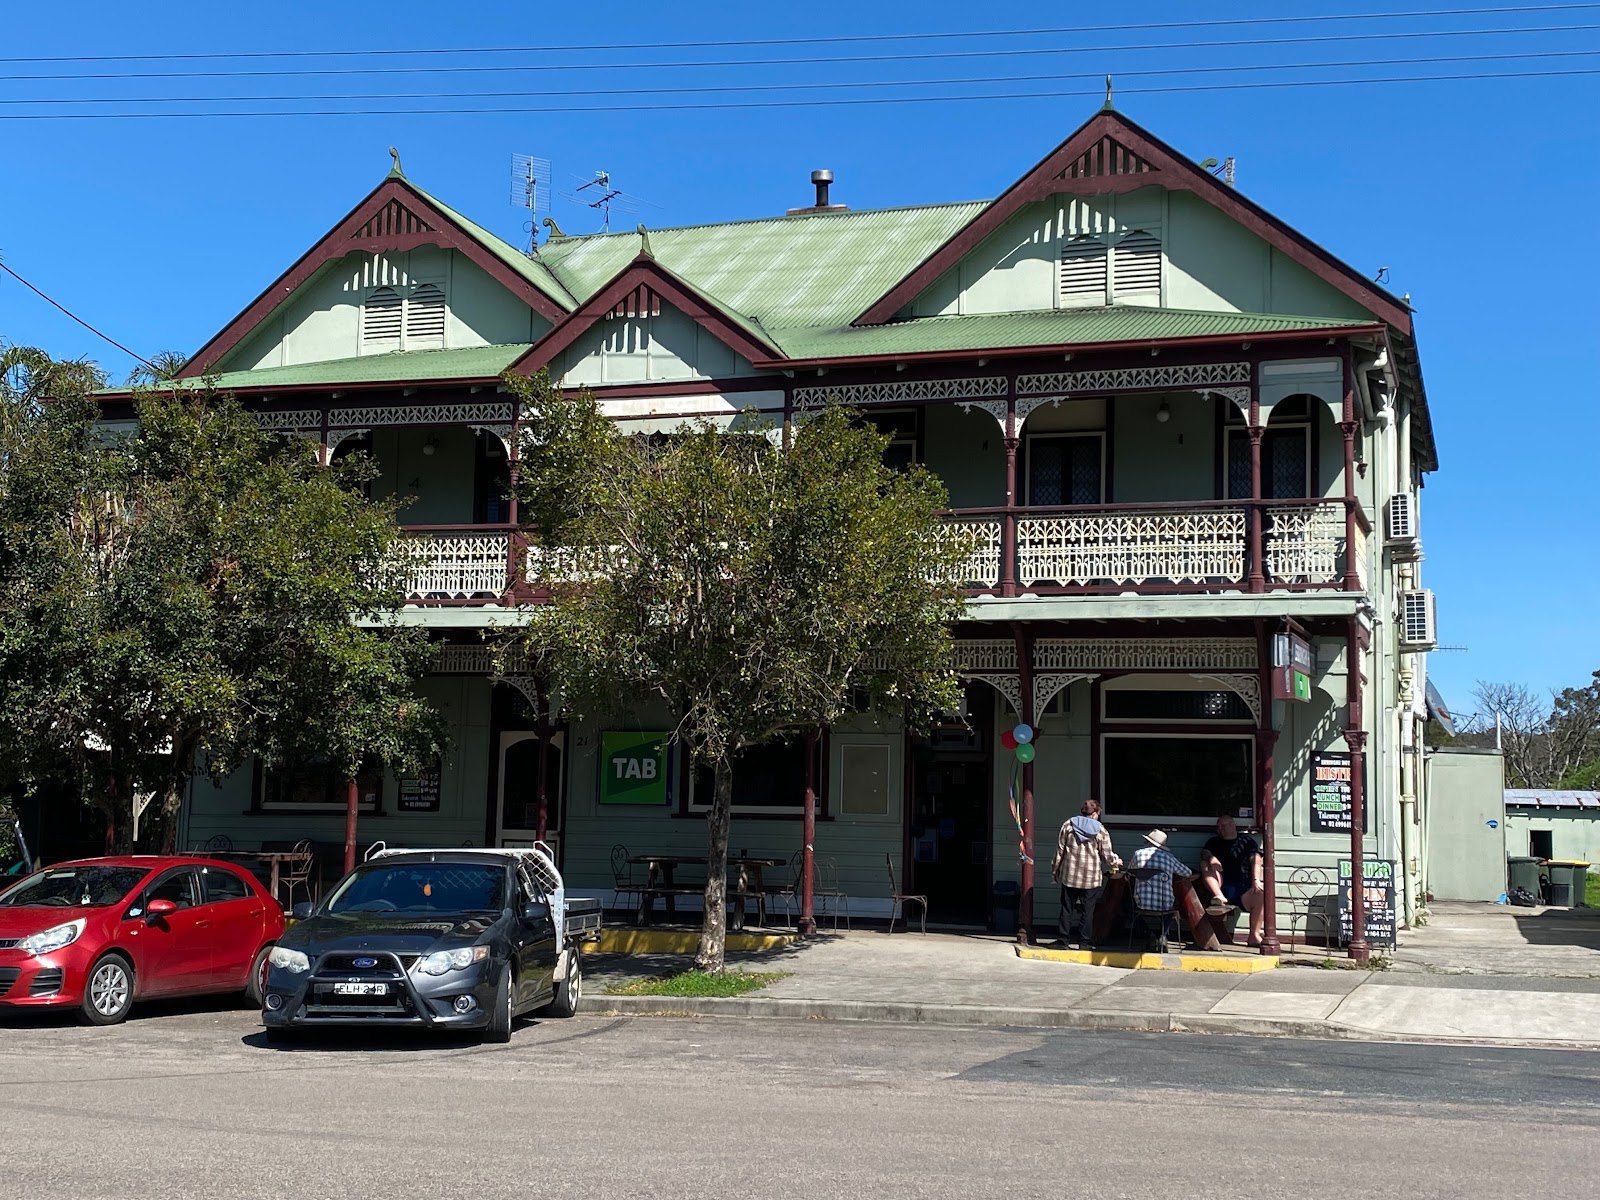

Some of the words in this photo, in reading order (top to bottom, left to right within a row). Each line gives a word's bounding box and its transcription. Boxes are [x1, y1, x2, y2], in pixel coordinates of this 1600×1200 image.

[612, 757, 657, 779] TAB
[1317, 793, 1340, 801] LUNCH
[1317, 802, 1342, 811] DINNER
